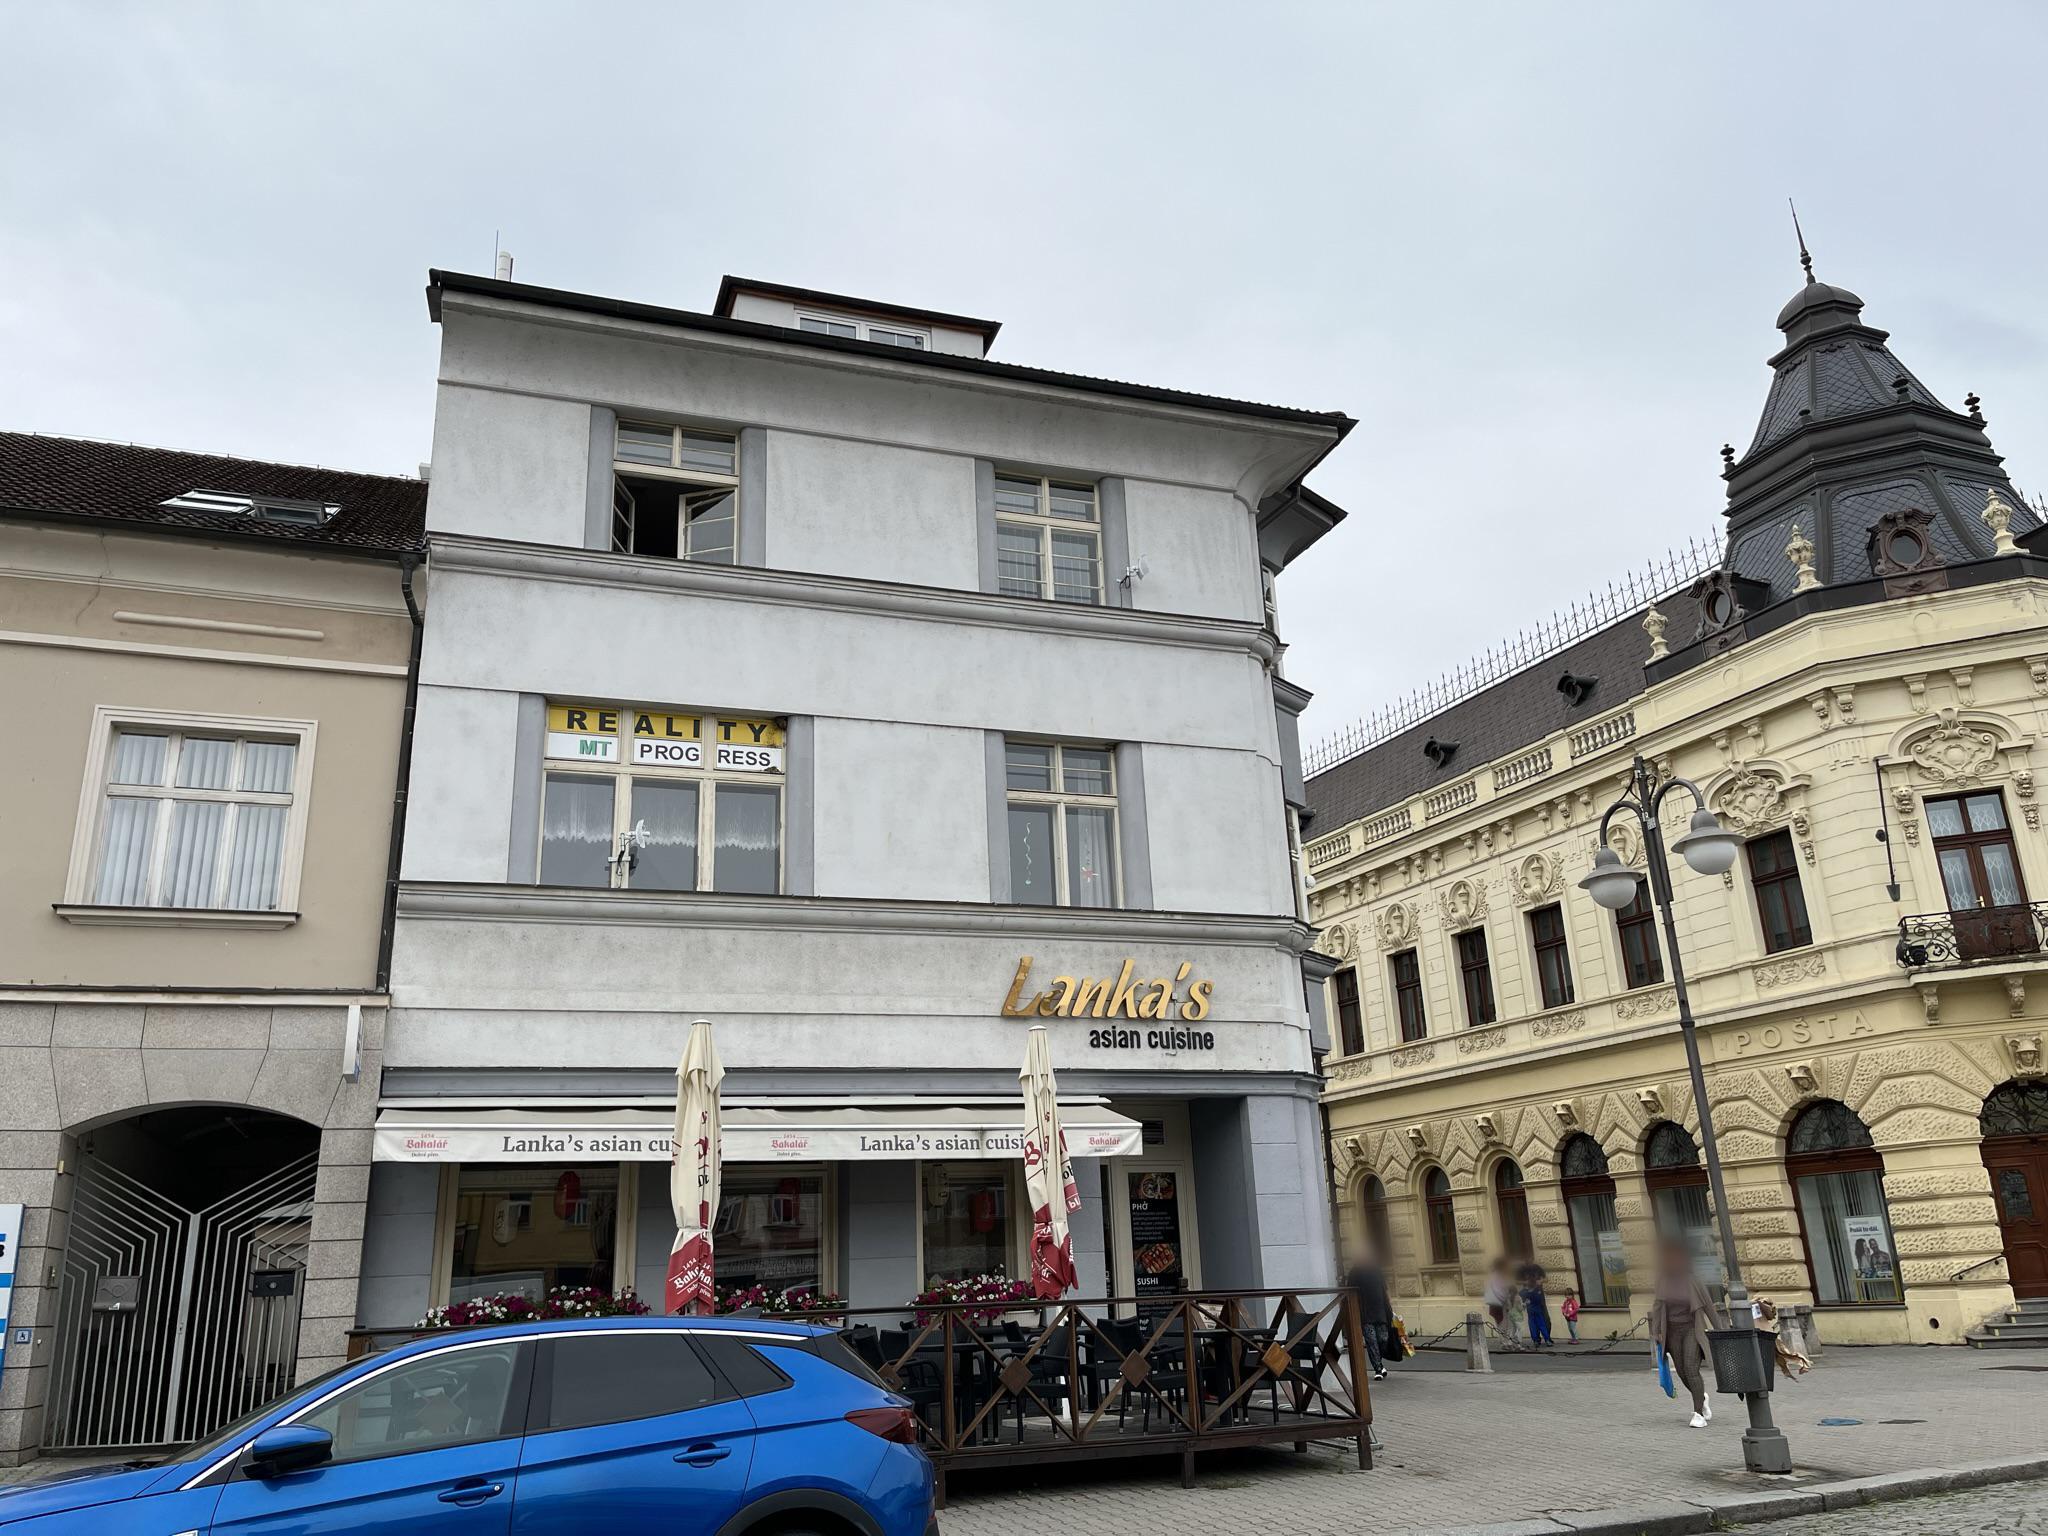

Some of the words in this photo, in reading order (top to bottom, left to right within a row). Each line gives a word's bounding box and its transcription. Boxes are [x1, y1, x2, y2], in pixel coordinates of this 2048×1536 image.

[579, 740, 612, 757] MT
[1001, 955, 1214, 1021] Lanka's
[1089, 1026, 1141, 1049] asian
[1148, 1027, 1214, 1050] cuisine
[1737, 1007, 1873, 1055] POŠTA
[502, 1134, 584, 1152] Lanka's
[589, 1135, 642, 1152] asian
[860, 1134, 930, 1151] Lanka's
[935, 1134, 980, 1150] asian
[985, 1134, 1024, 1150] cuisi
[1137, 1278, 1159, 1286] SUSHI
